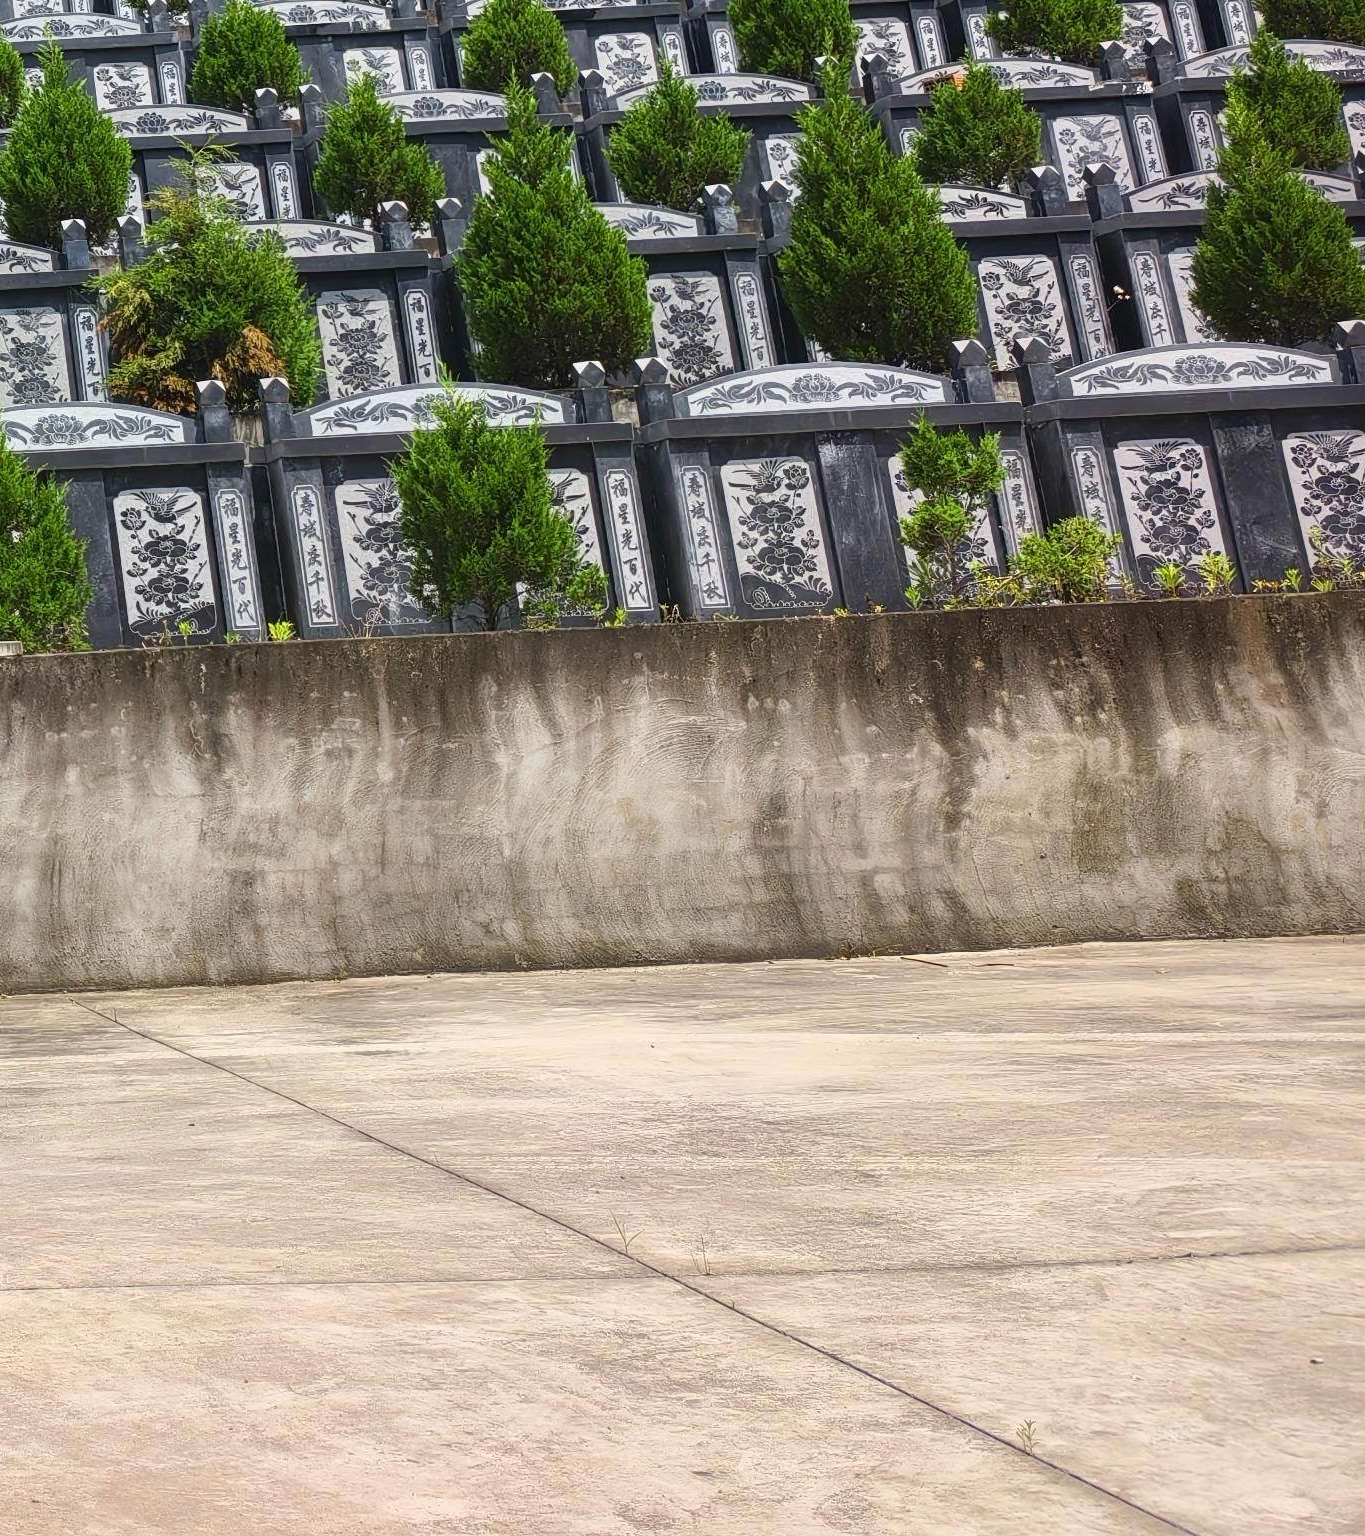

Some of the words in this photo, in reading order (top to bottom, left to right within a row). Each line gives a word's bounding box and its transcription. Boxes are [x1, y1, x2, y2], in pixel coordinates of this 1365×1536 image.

[408, 296, 434, 379] 福星光百
[739, 278, 770, 370] 福星光百
[1139, 260, 1169, 338] 寿域庆千
[220, 495, 258, 624] 福星光百代
[297, 490, 334, 621] 寿域庆千秋
[609, 477, 649, 603] 福星光百代
[684, 473, 727, 601] 寿域庆千秋
